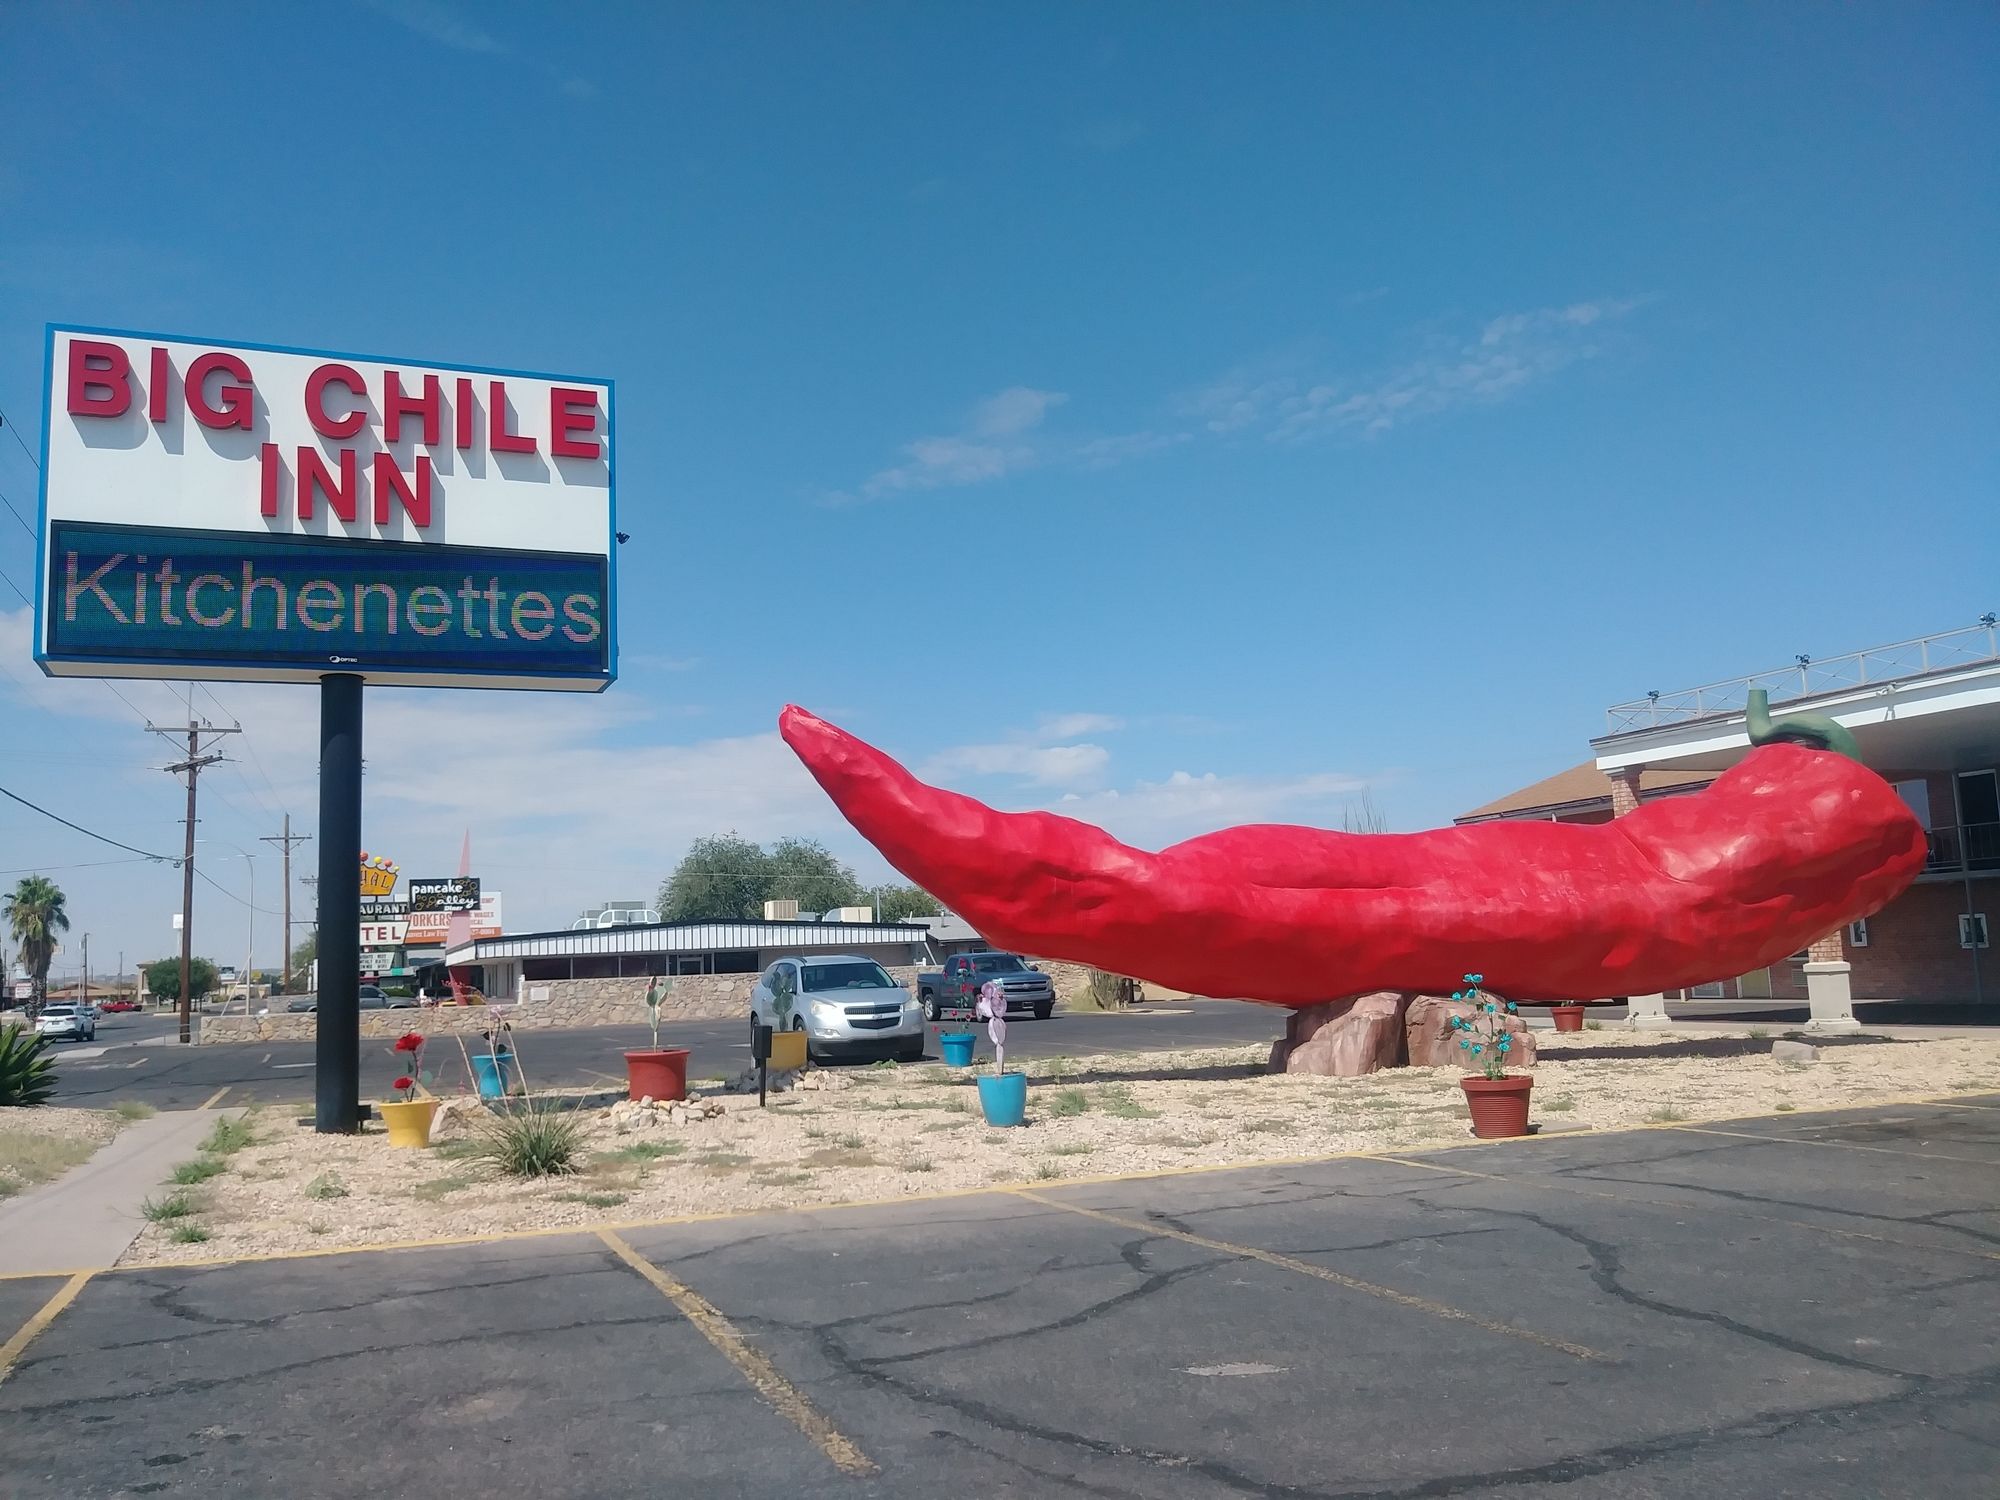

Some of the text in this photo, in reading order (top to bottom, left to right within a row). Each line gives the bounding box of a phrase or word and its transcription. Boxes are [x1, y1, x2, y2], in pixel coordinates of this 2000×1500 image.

[67, 339, 600, 459] BIG CHILE
[260, 442, 431, 528] INN
[63, 550, 602, 643] Kitchenettes
[411, 879, 463, 904] pancake
[436, 895, 478, 909] alley
[361, 926, 402, 941] TEL
